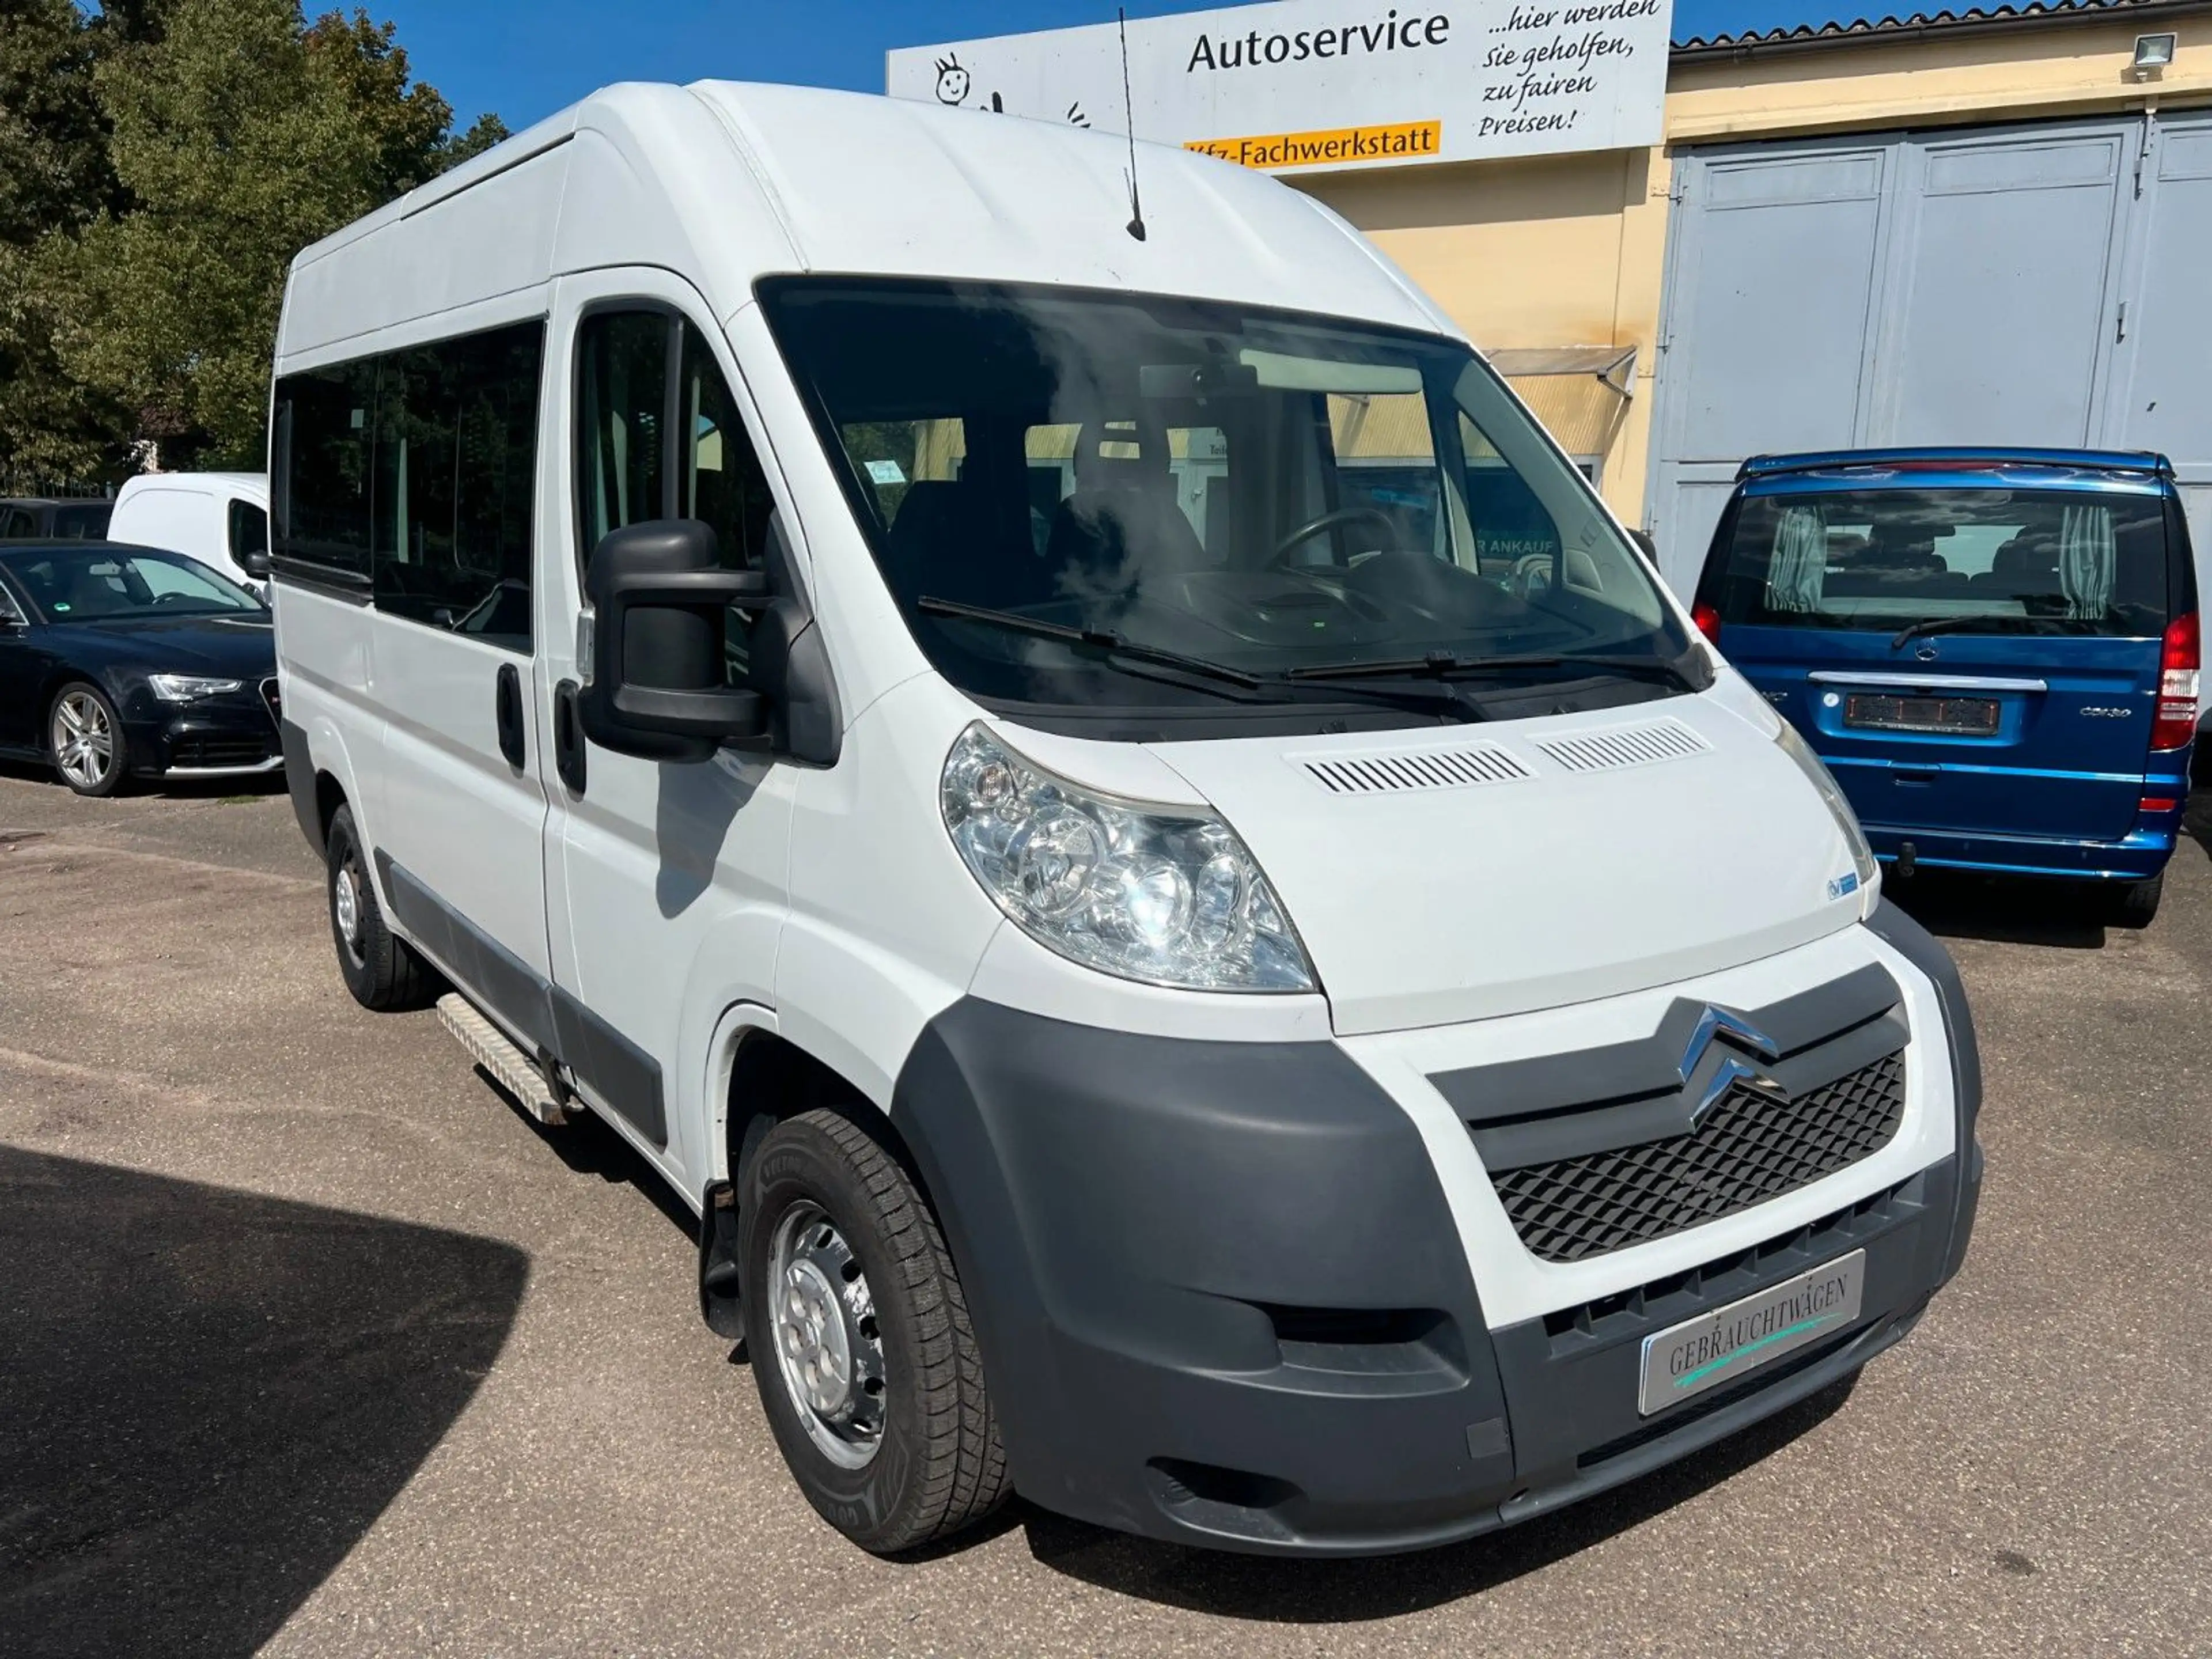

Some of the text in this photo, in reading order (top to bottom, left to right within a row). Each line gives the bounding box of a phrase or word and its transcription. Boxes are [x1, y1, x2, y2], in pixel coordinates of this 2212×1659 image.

[1488, 0, 1661, 33] ...hier werden
[1187, 9, 1450, 73] Autoservice
[1516, 31, 1634, 77] geholfen,
[1482, 72, 1597, 112] zu fairen
[1478, 109, 1577, 137] Preisen!
[1189, 128, 1433, 165] fz-Fachwerkstatt
[1490, 539, 1554, 554] ANKAUF
[1670, 1274, 1847, 1376] GEBRAUCHTWAGEN
